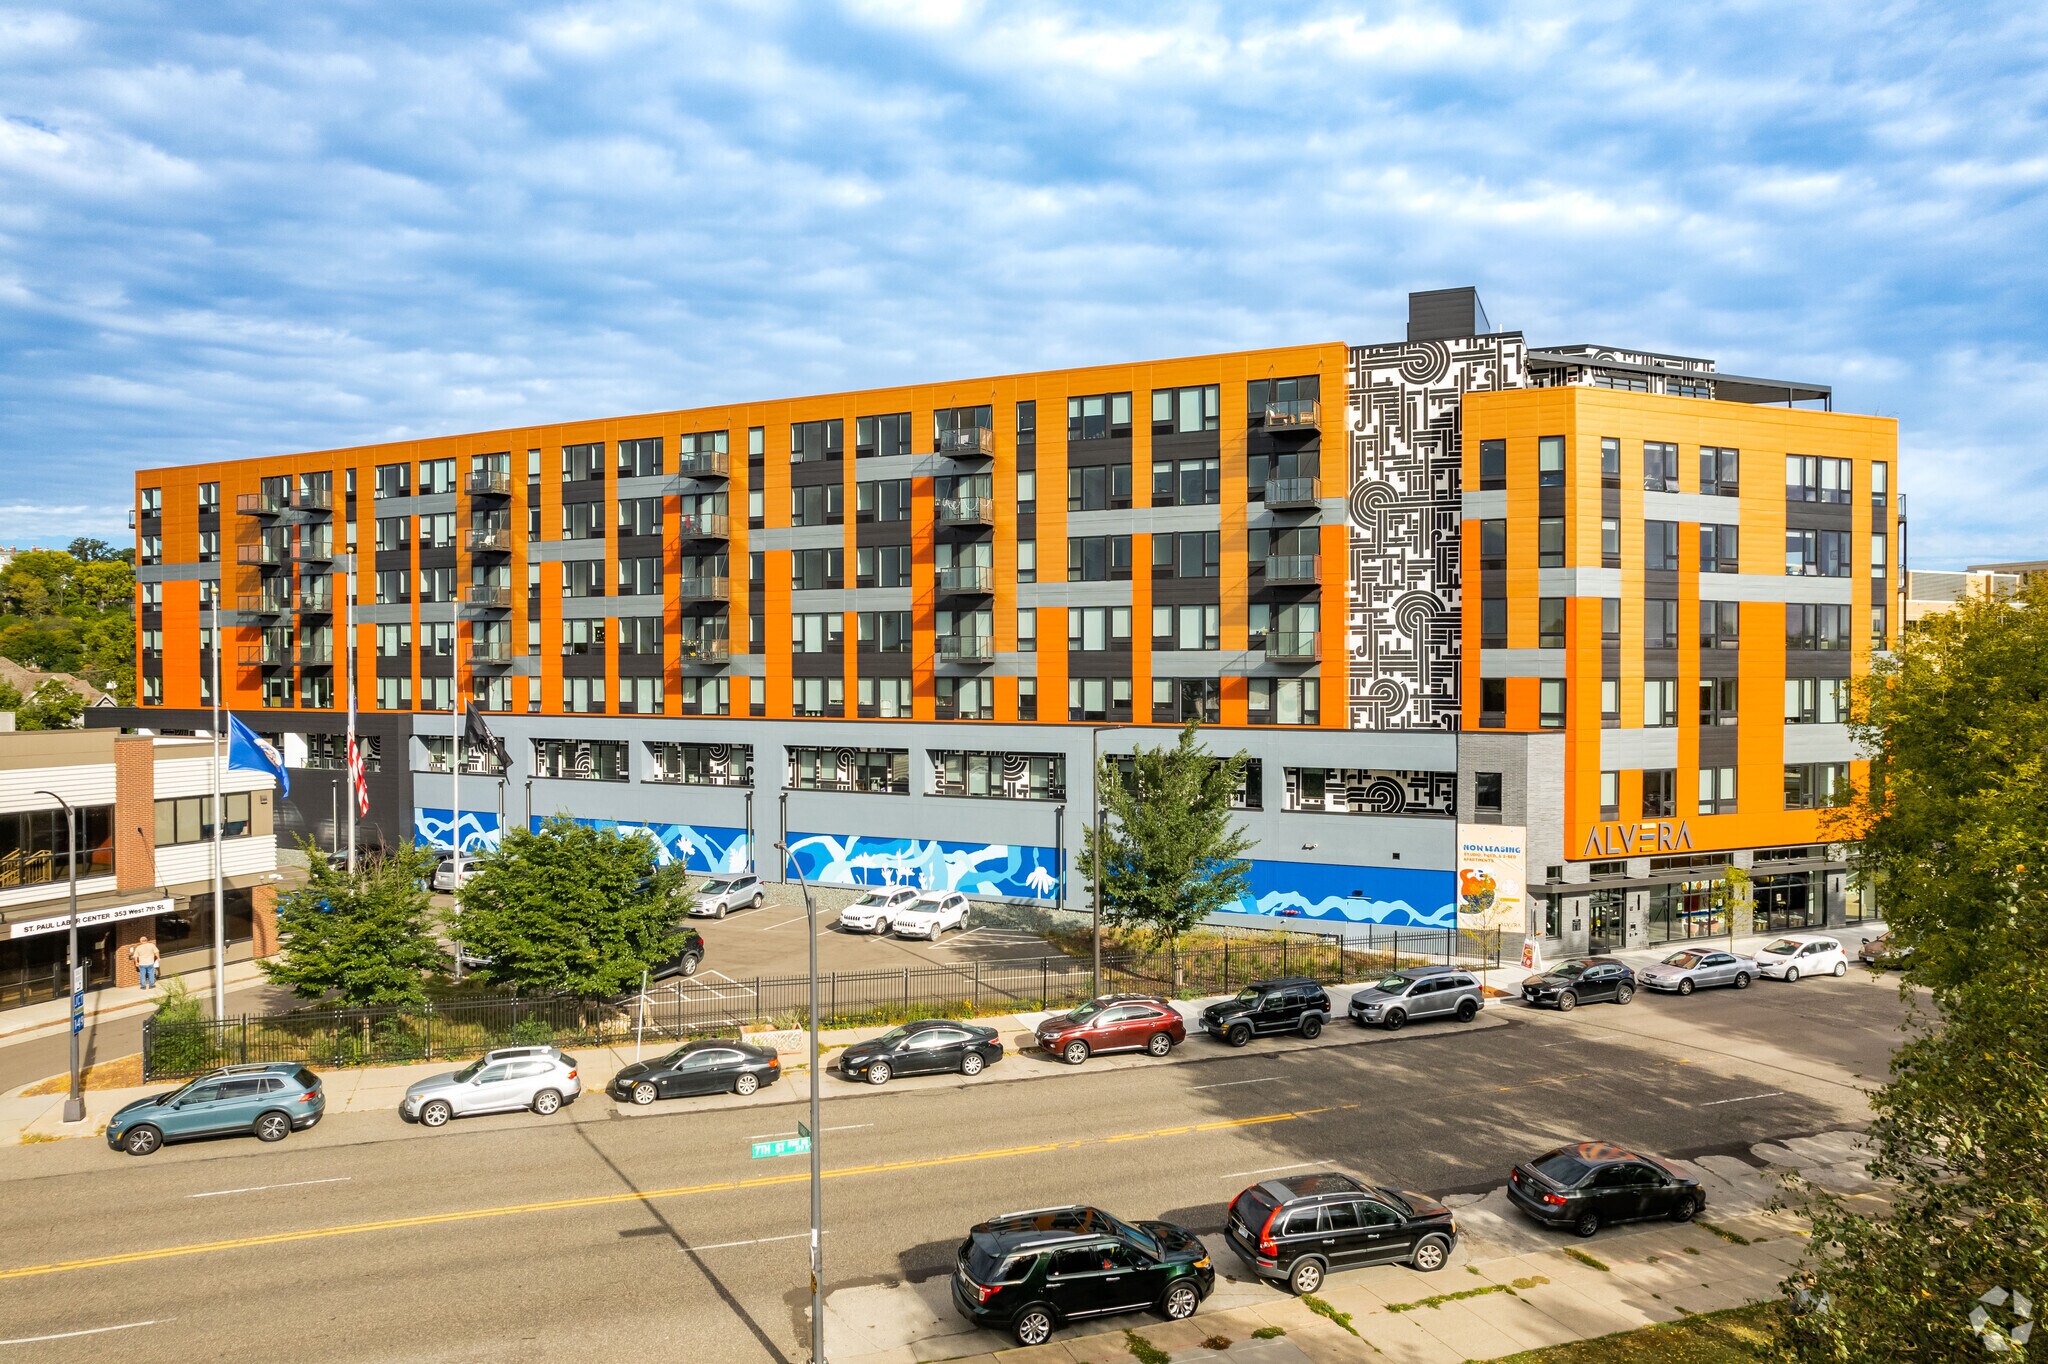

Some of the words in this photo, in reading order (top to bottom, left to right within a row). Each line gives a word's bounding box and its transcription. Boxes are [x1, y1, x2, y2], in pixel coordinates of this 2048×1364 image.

[1583, 820, 1693, 856] ALVERA
[37, 922, 54, 931] PAUL
[56, 917, 81, 928] LABR
[82, 913, 110, 923] CENTER
[114, 910, 127, 918] 353
[129, 907, 144, 915] West
[755, 1144, 770, 1156] 7TH
[775, 1142, 786, 1153] ST
